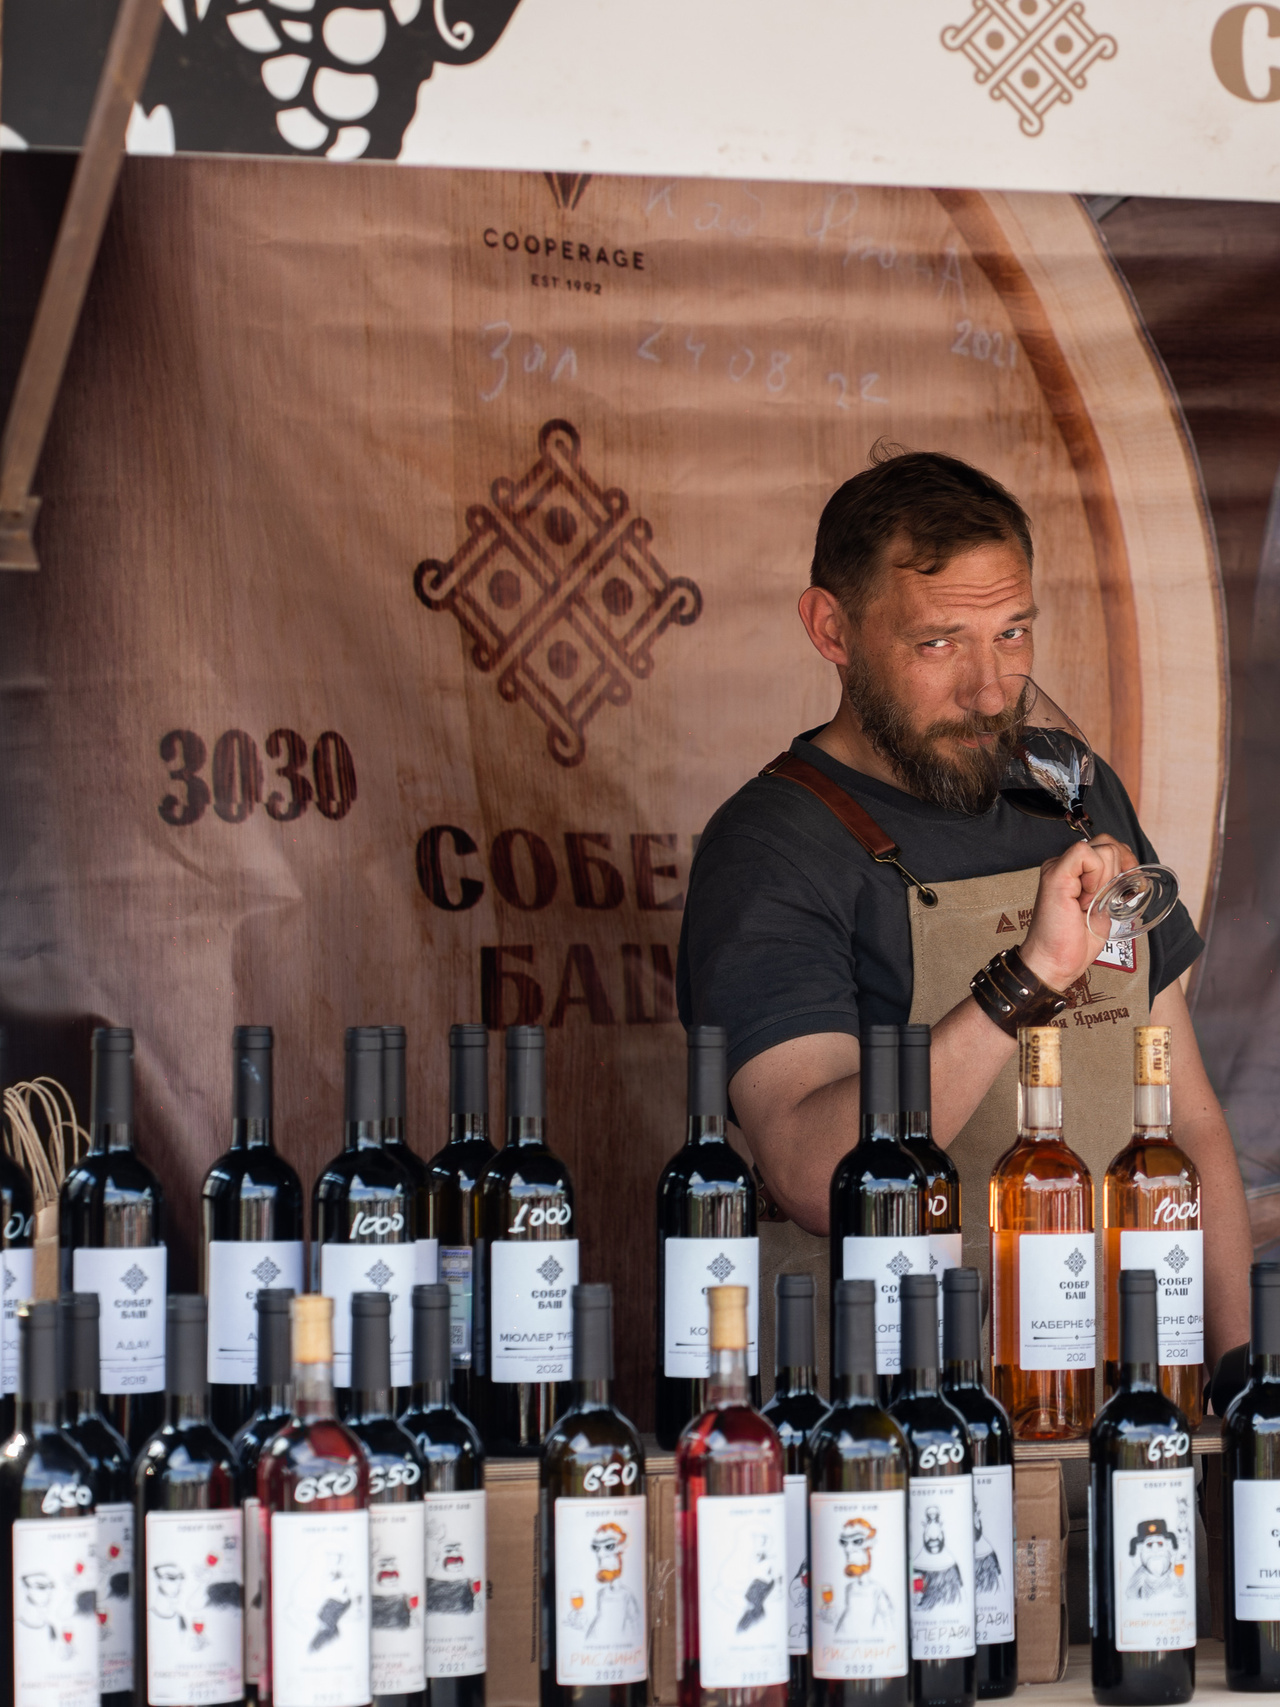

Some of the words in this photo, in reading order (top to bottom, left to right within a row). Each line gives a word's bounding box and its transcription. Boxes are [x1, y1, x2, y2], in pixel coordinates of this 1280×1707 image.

[483, 227, 646, 272] COOPERAGE
[531, 274, 558, 290] EST
[566, 278, 602, 296] 1992
[158, 728, 358, 826] 3030
[416, 824, 701, 912] СОБЕ
[1073, 1006, 1130, 1029] Ярмарка
[1152, 1038, 1162, 1071] БАШ
[508, 1203, 572, 1234] 1000
[350, 1211, 405, 1240] 1000
[1059, 1281, 1090, 1290] СОБЕР
[1158, 1277, 1193, 1286] СОБЕР
[531, 1289, 567, 1299] СОБЕР
[1065, 1291, 1086, 1300] БАШ
[1164, 1287, 1189, 1296] БАШ
[538, 1300, 562, 1310] БАШ
[1031, 1320, 1083, 1330] КАБЕРНЕ
[1157, 1316, 1185, 1325] ЕРНЕ
[500, 1332, 553, 1342] МЮЛЛЕР
[1066, 1353, 1087, 1362] 2021
[1166, 1349, 1189, 1358] 2021
[536, 1364, 563, 1374] 2022
[121, 1376, 147, 1386] 2019
[1147, 1432, 1190, 1462] 650
[919, 1442, 965, 1469] 650
[583, 1461, 638, 1492] 650
[294, 1470, 358, 1503] 650
[41, 1483, 92, 1514] 650
[976, 1612, 1009, 1626] РАВИ
[912, 1626, 971, 1643] ПЕРАВИ
[976, 1631, 988, 1641] 22
[1155, 1636, 1181, 1646] 2022
[821, 1644, 897, 1661] РИСЛИНГ
[923, 1645, 951, 1656] 2022
[438, 1662, 465, 1673] 2021
